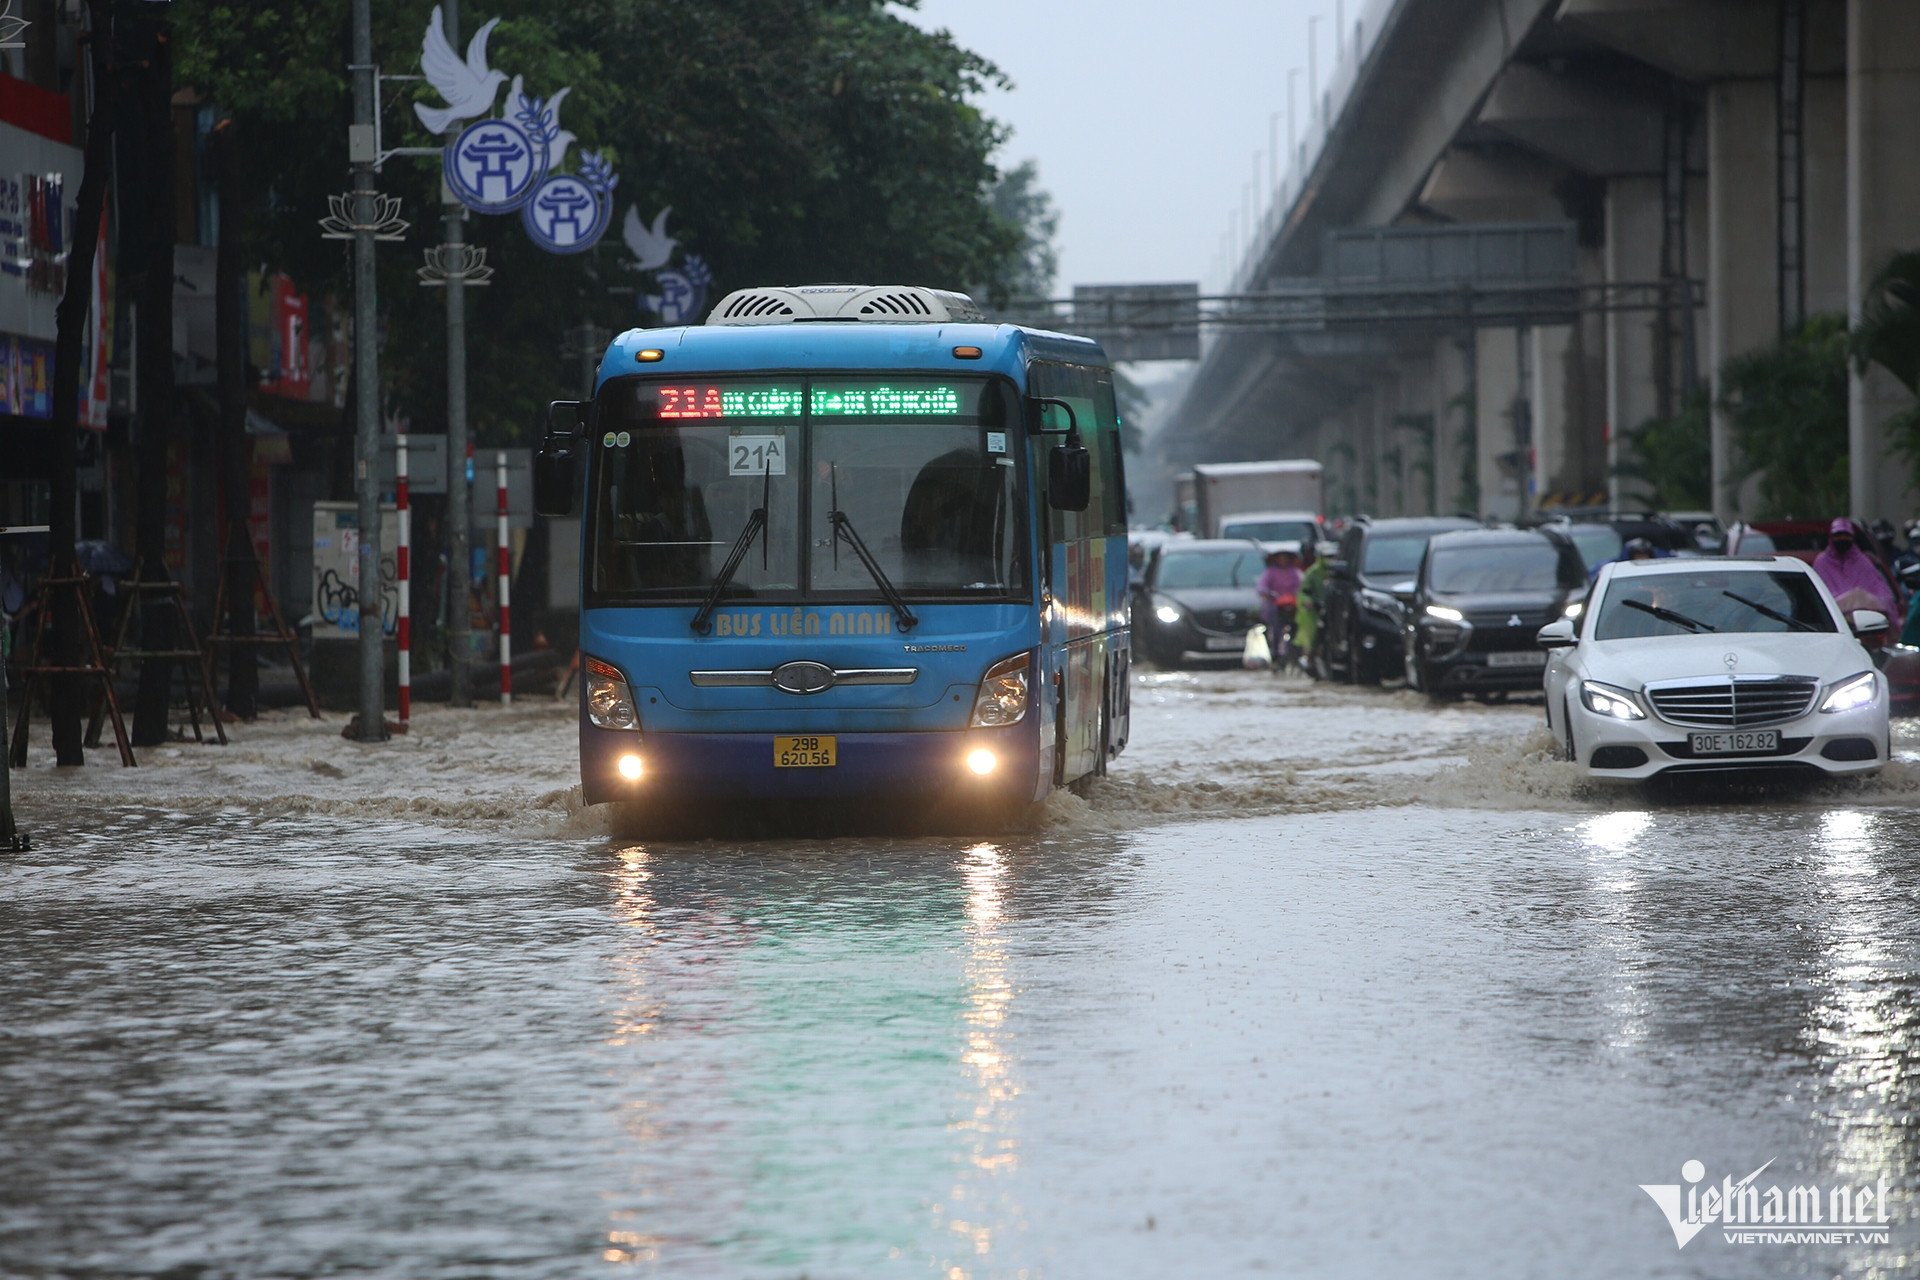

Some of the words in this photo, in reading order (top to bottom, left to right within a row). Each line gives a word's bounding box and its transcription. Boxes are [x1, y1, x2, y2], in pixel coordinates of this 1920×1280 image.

[659, 388, 722, 418] 21A
[733, 440, 780, 470] 21A
[716, 613, 761, 636] BUS
[770, 607, 820, 636] LIÊN
[829, 612, 891, 635] NINH
[903, 644, 967, 653] TRACOMECO
[791, 737, 819, 751] 29B
[1694, 733, 1775, 752] 30E-162.82
[781, 752, 830, 766] 620.56
